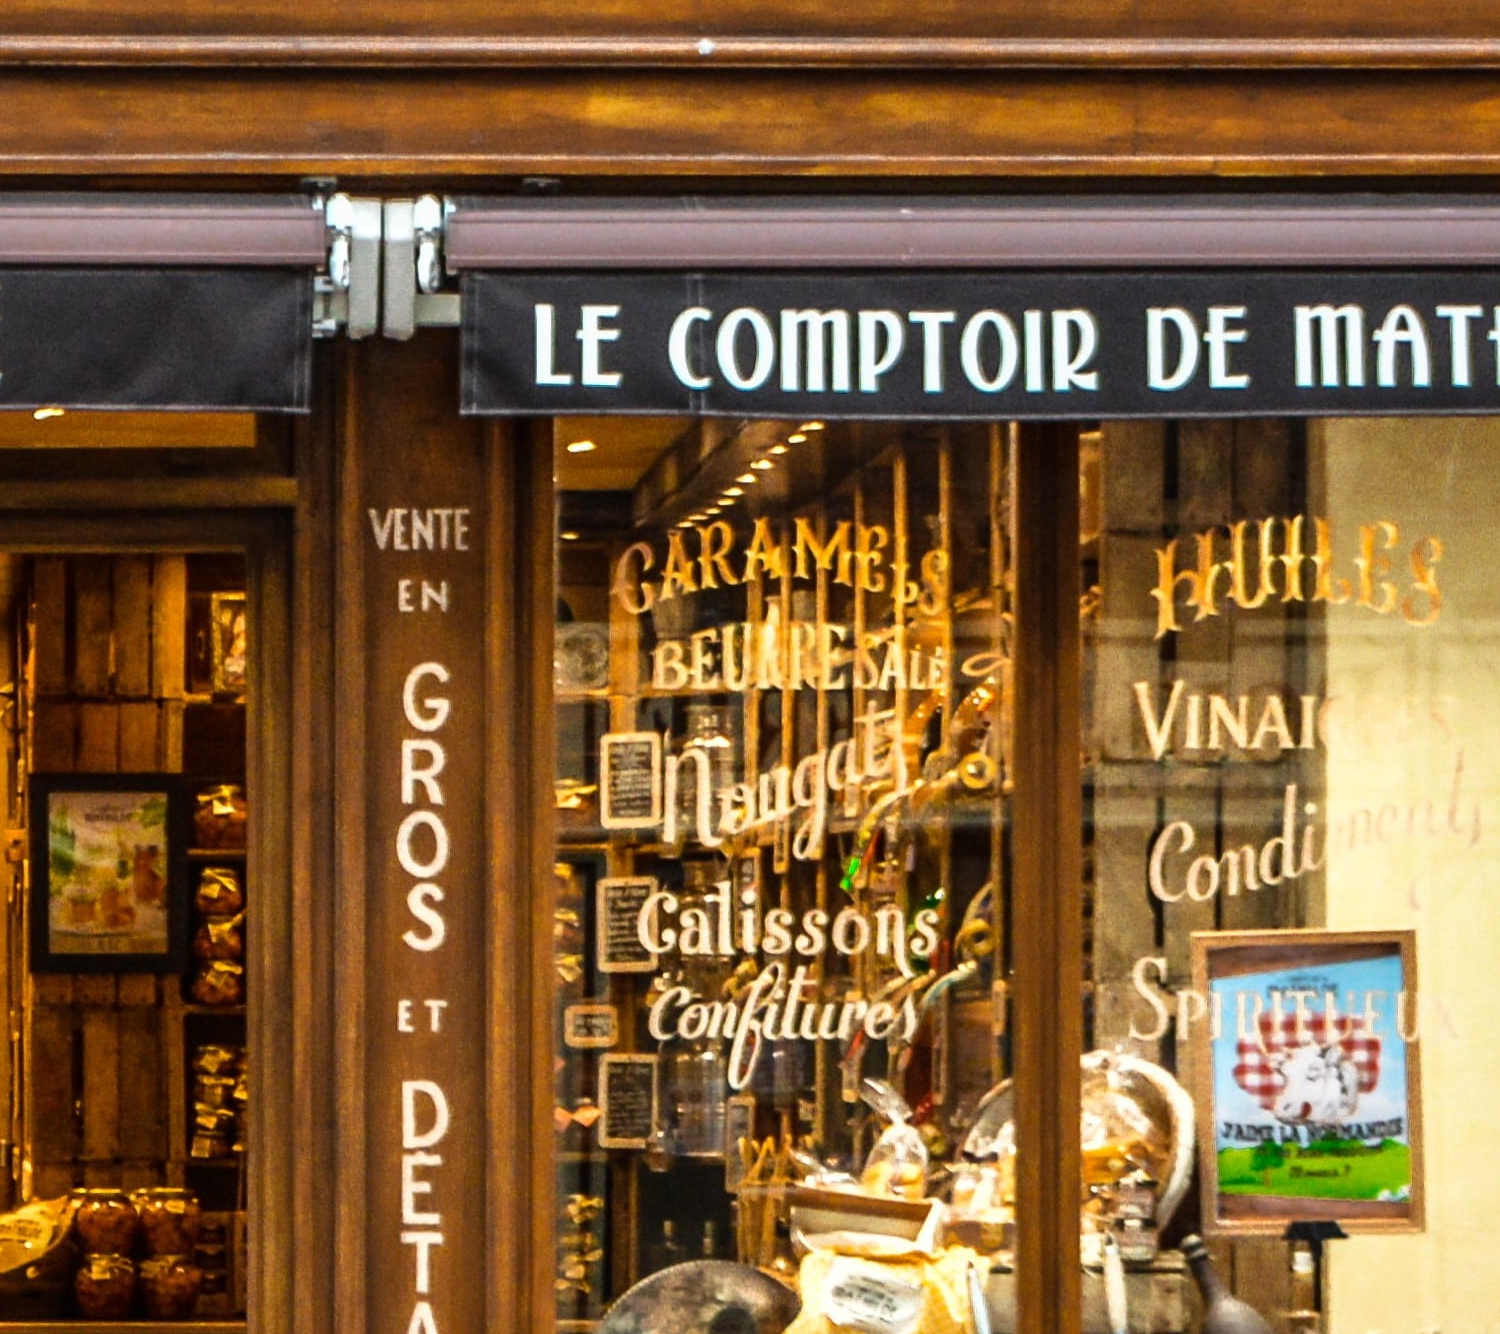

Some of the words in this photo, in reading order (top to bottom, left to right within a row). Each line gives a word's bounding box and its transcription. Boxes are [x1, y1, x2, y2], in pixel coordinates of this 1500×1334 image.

[534, 302, 623, 389] LE
[666, 305, 1099, 395] COMPTOIR
[1145, 306, 1251, 393] DE
[367, 507, 471, 553] VENTE
[611, 515, 949, 617] CARAMELS
[1150, 514, 1446, 641] HUILES
[396, 578, 451, 614] EN
[652, 619, 849, 692] BEURRE
[394, 660, 453, 954] GROS
[661, 697, 910, 860] Nougats
[635, 878, 942, 979] Calissons
[396, 997, 450, 1034] ET
[647, 963, 918, 1092] Confitures
